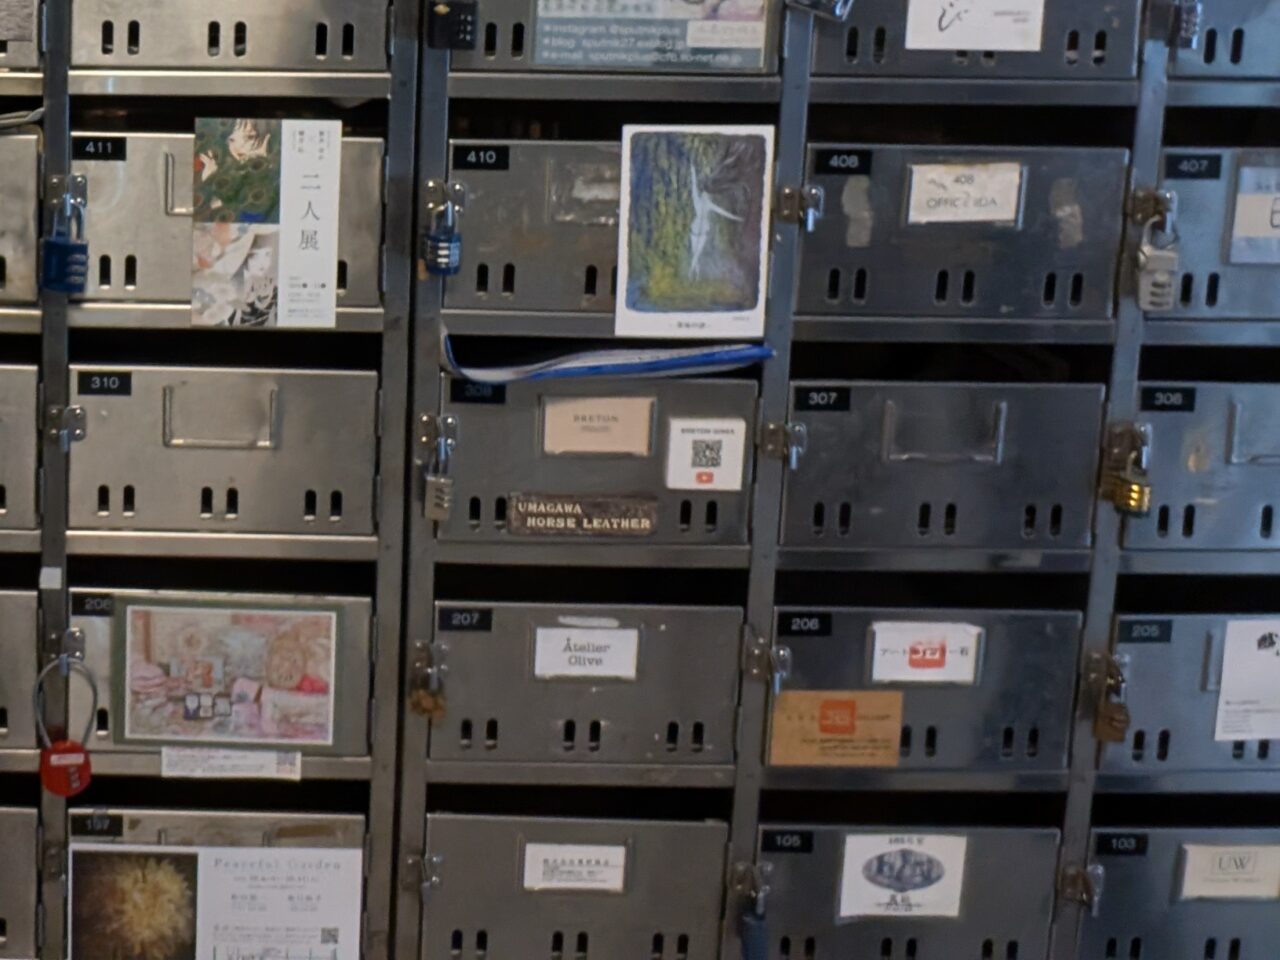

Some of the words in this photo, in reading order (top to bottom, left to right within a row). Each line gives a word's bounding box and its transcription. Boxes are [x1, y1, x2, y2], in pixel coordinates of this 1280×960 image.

[85, 141, 112, 154] 411
[466, 150, 497, 164] 410
[828, 155, 859, 169] 408
[1178, 159, 1209, 173] 407
[953, 174, 975, 185] 408
[298, 173, 322, 252] 二人展
[90, 376, 120, 389] 310
[808, 391, 838, 405] 307
[518, 501, 582, 514] UMAGAWA
[526, 516, 577, 529] HORSE
[582, 517, 652, 530] LEATHER
[451, 613, 479, 626] 207
[791, 617, 820, 631] 206
[1131, 624, 1160, 638] 205
[568, 654, 604, 666] Olive
[775, 835, 801, 847] 105
